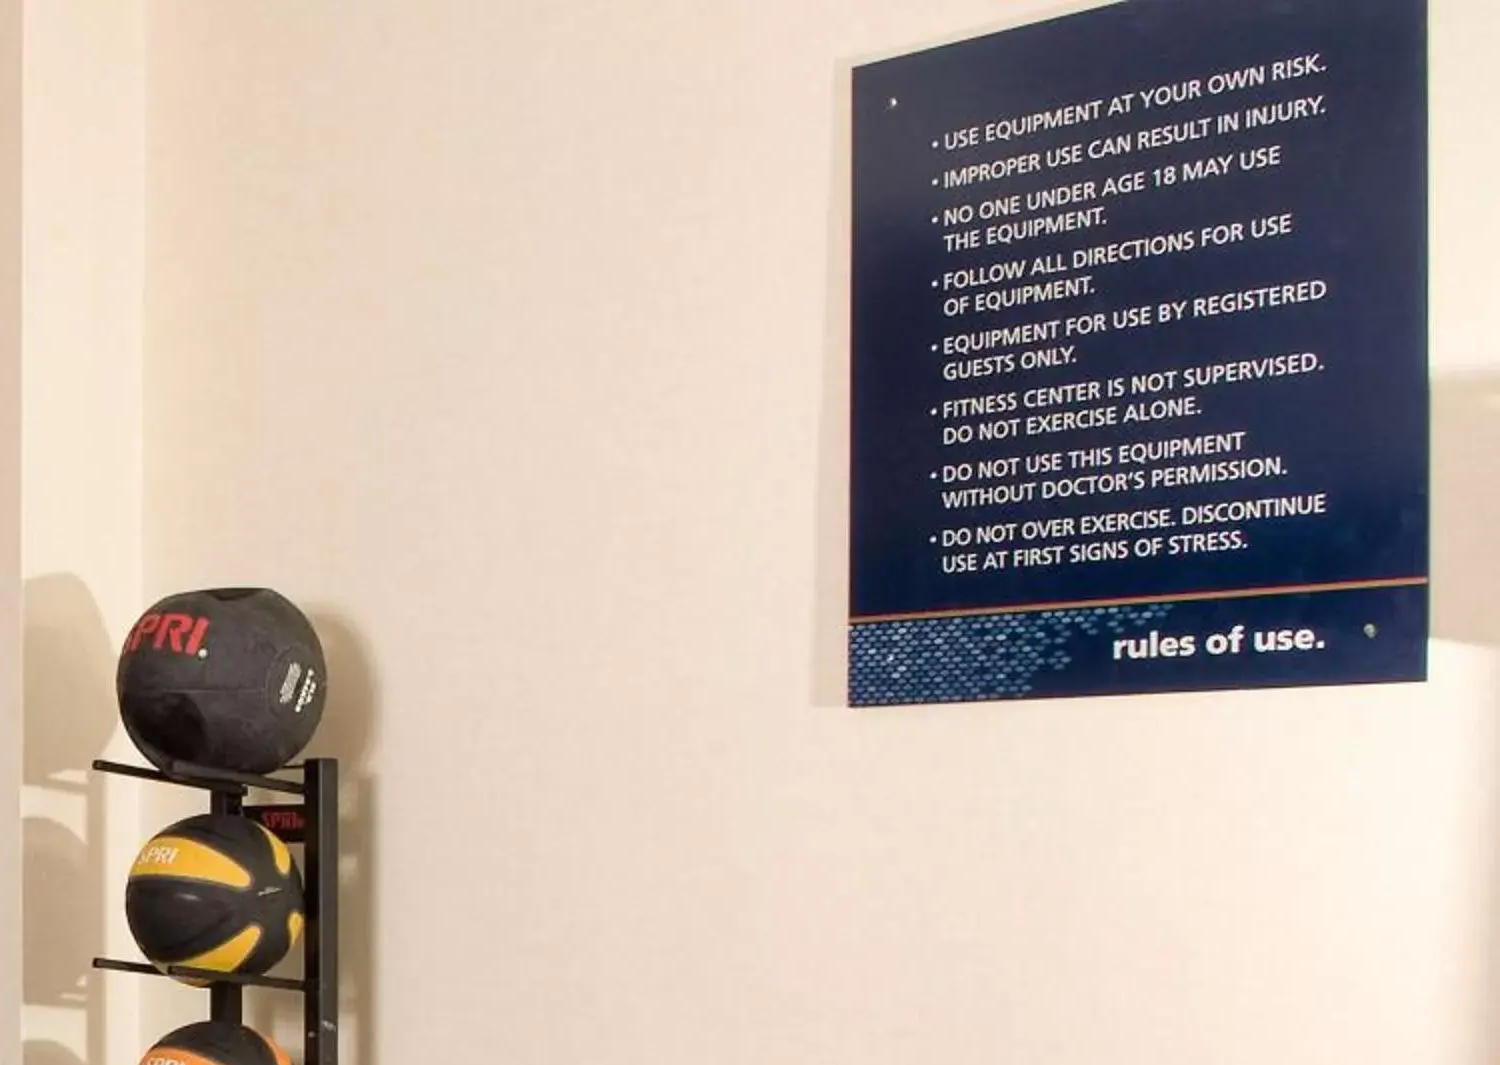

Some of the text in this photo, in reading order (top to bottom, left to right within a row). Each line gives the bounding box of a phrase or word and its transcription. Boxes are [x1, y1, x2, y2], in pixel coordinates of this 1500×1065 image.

[944, 52, 1327, 151] USE EQUIPMENT AT YOUR OWN RISK.
[944, 95, 1326, 189] IMPROPER USE CAN RESULT IN INJURY.
[943, 145, 1281, 227] NO ONE UNDER AGE 18 MAY USE
[943, 206, 1107, 253] THE EQUIPMENT.
[943, 213, 1292, 291] FOLLOW ALL DIRECTIONS FOR USE
[943, 275, 1095, 317] OF EQUIPMENT.
[943, 279, 1327, 355] EQUIPMENT FOR USE BY REGISTERED
[942, 345, 1077, 381] GUESTS ONLY.
[943, 352, 1325, 419] FITNESS CENTER IS NOT SUPERVISED.
[943, 395, 1202, 445] DO NOT EXERCISE ALONE.
[941, 455, 1288, 509] WITHOUT DOCTOR'S PERMISSION.
[942, 431, 1247, 483] DO NOT USE THIS EQUIPMENT
[942, 493, 1327, 548] DO NOT OVER EXERCISE. DISCONTINUE
[942, 529, 1249, 574] USE AT FIRST SIGNS OF STRESS.
[1112, 624, 1326, 660] rules of use.
